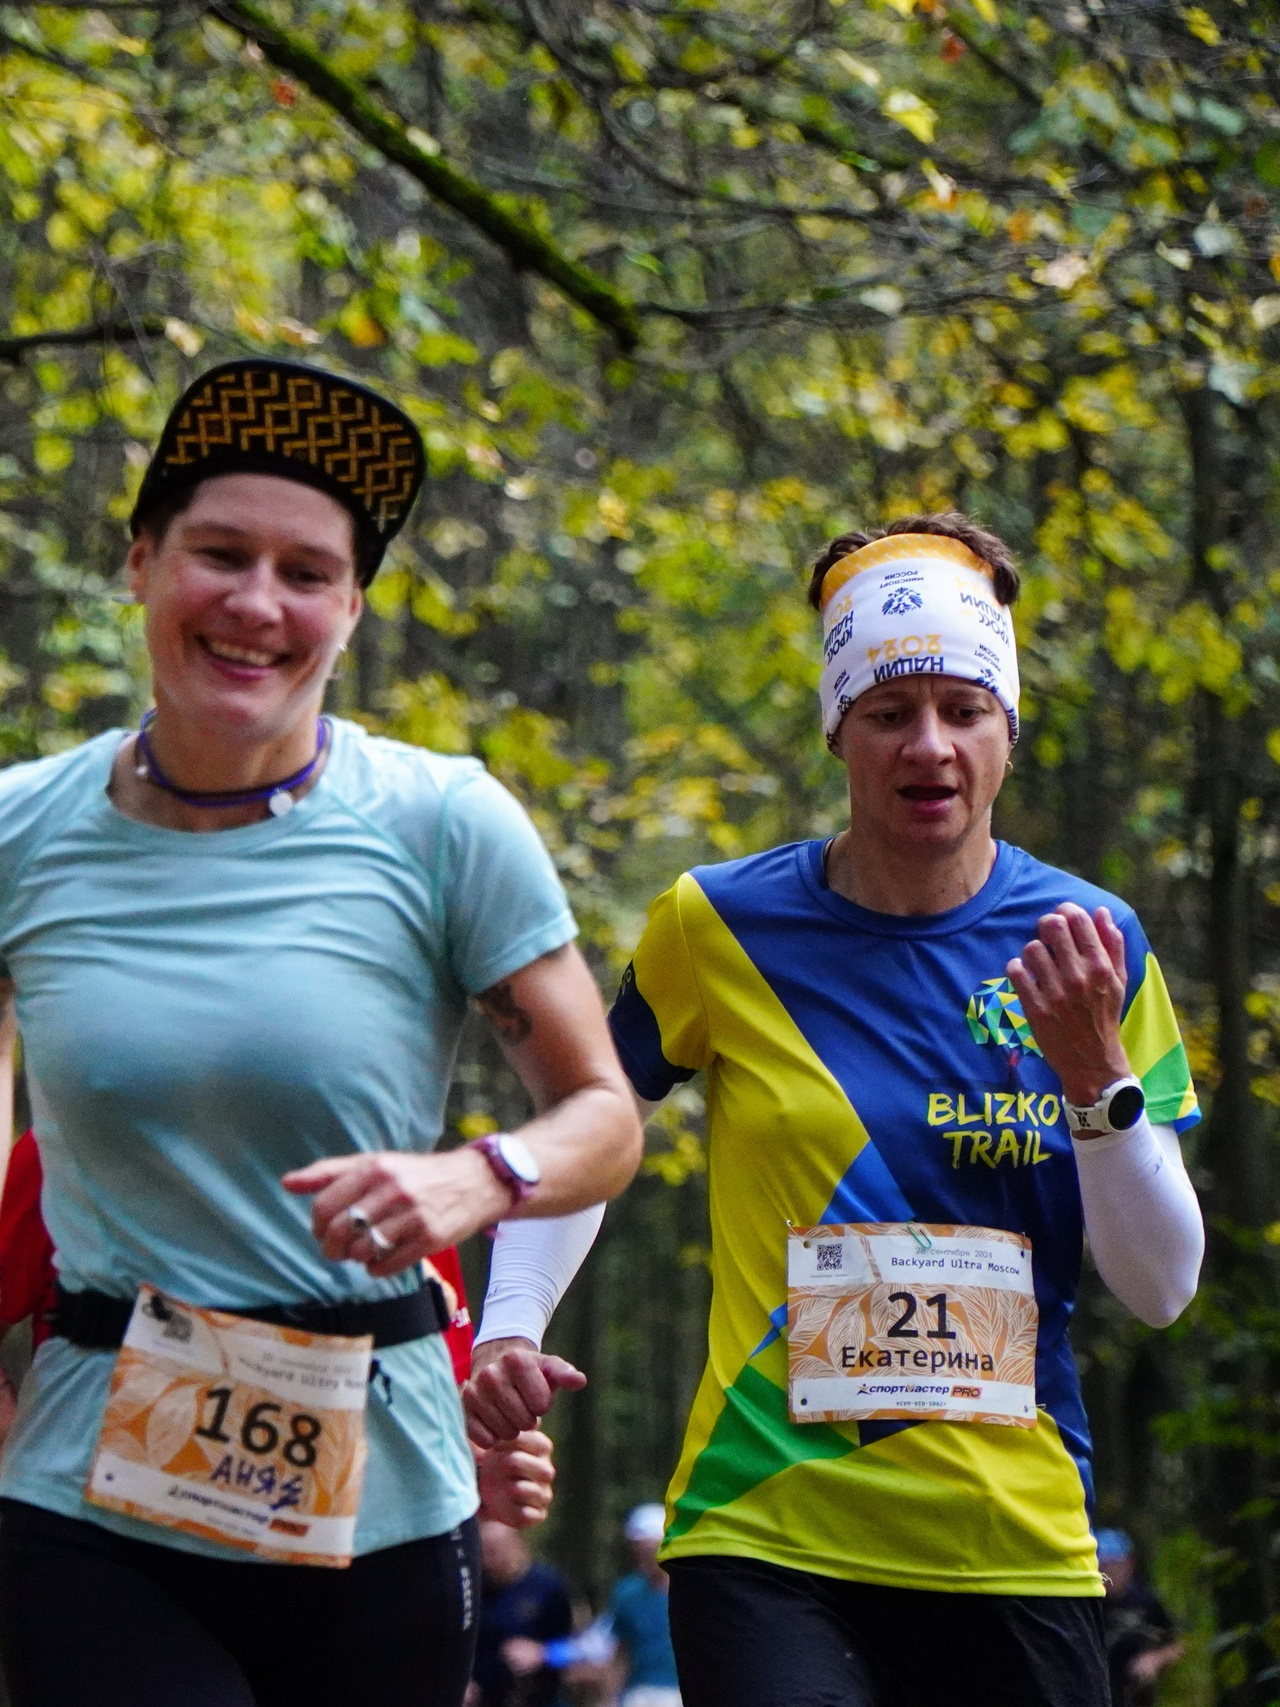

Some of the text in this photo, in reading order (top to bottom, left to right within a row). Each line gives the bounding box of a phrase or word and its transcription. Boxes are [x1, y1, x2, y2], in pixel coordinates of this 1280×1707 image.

[867, 634, 942, 665] 2024
[873, 657, 944, 684] НАЦИИ
[926, 1091, 1061, 1127] BLIZKO
[942, 1128, 1053, 1170] TRAIL
[891, 1257, 1020, 1276] Backyard Ultra Moscow
[887, 1291, 957, 1340] 21
[841, 1346, 995, 1374] Екатерина
[952, 1387, 981, 1398] PRO
[194, 1387, 322, 1468] 168
